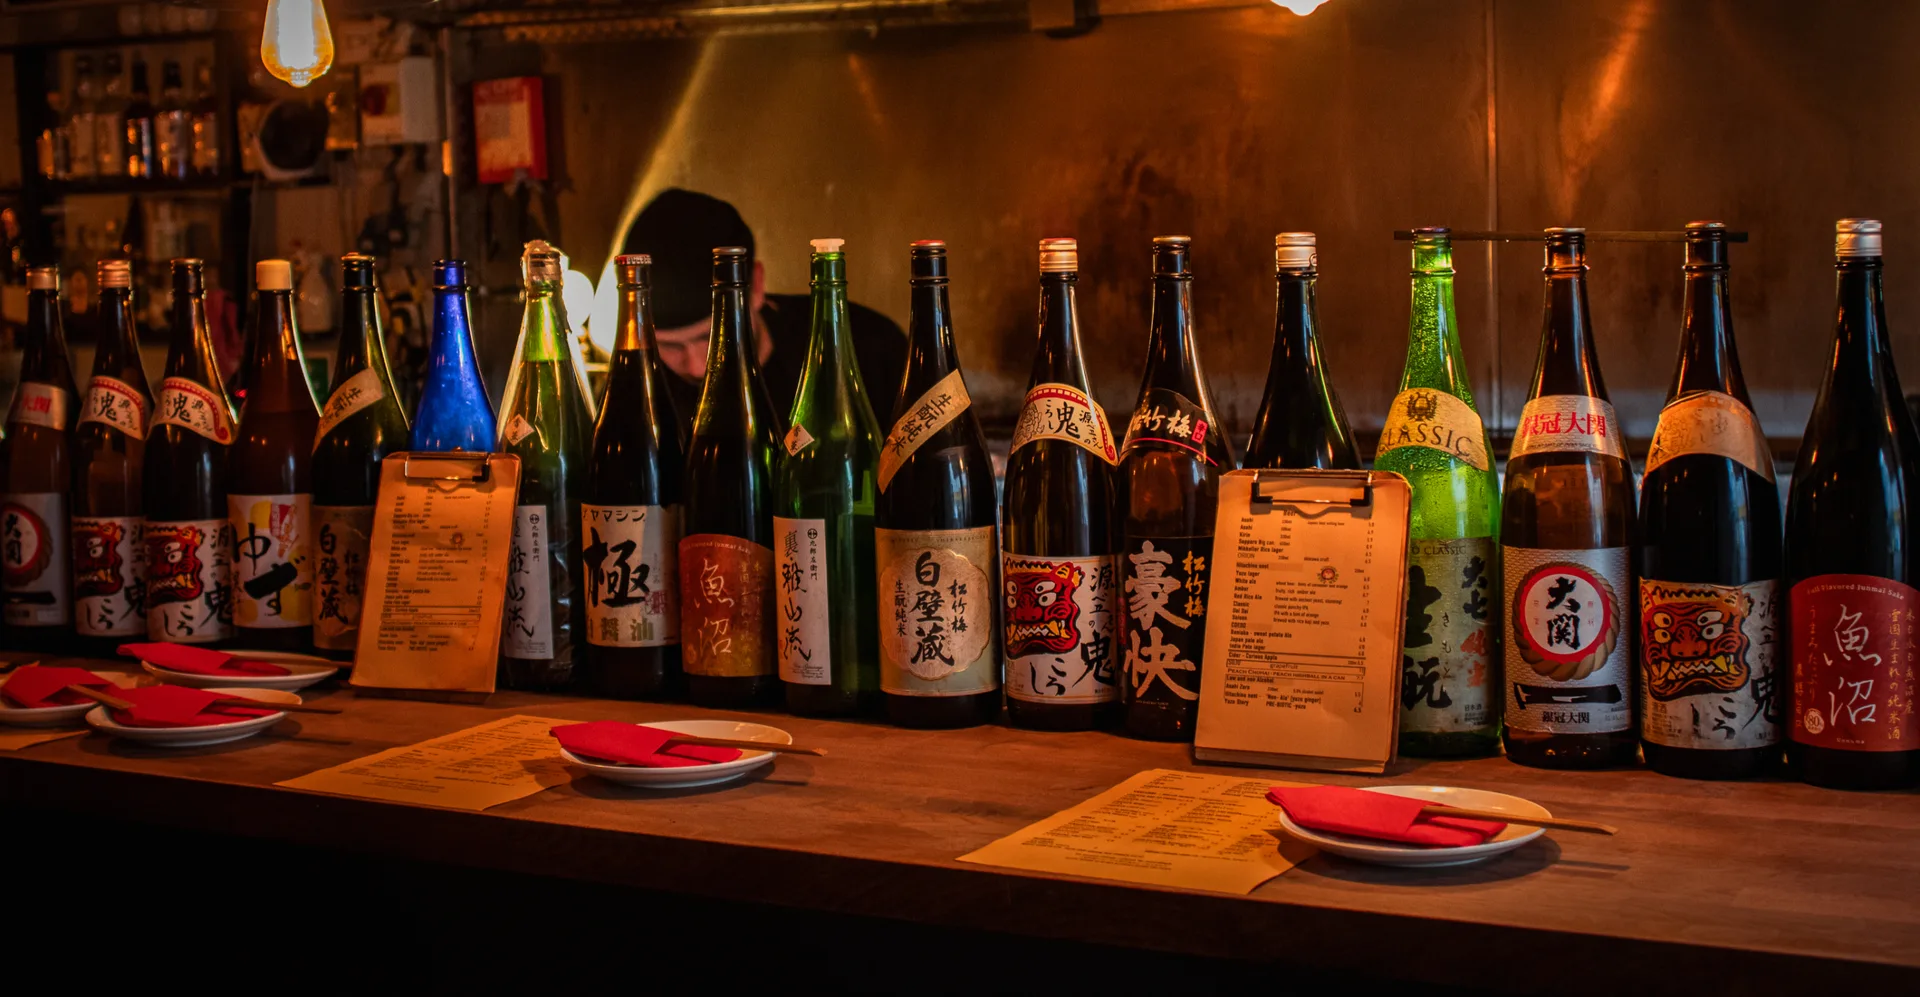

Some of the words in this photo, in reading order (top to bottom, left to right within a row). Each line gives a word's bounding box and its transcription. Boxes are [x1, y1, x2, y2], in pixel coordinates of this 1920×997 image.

[1045, 399, 1054, 430] ころし
[1053, 401, 1081, 439] 鬼
[1522, 411, 1607, 438] 銀冠大関
[1379, 421, 1472, 457] CLASSIC
[582, 525, 651, 608] 極
[1182, 551, 1207, 618] 松竹梅
[693, 557, 735, 657] 魚沼
[909, 551, 954, 666] 白壁蔵
[947, 579, 968, 633] 松竹梅
[1546, 576, 1581, 652] 大関
[1857, 584, 1886, 594] Junmai
[1887, 589, 1905, 600] Sake
[1124, 540, 1200, 700] 豪快
[1270, 662, 1298, 670] grapefruit
[1824, 604, 1882, 727] 魚沼
[1236, 698, 1249, 706] Story
[1265, 700, 1292, 708] PRE-BIOTIC
[1542, 710, 1590, 724] 銀冠大関
